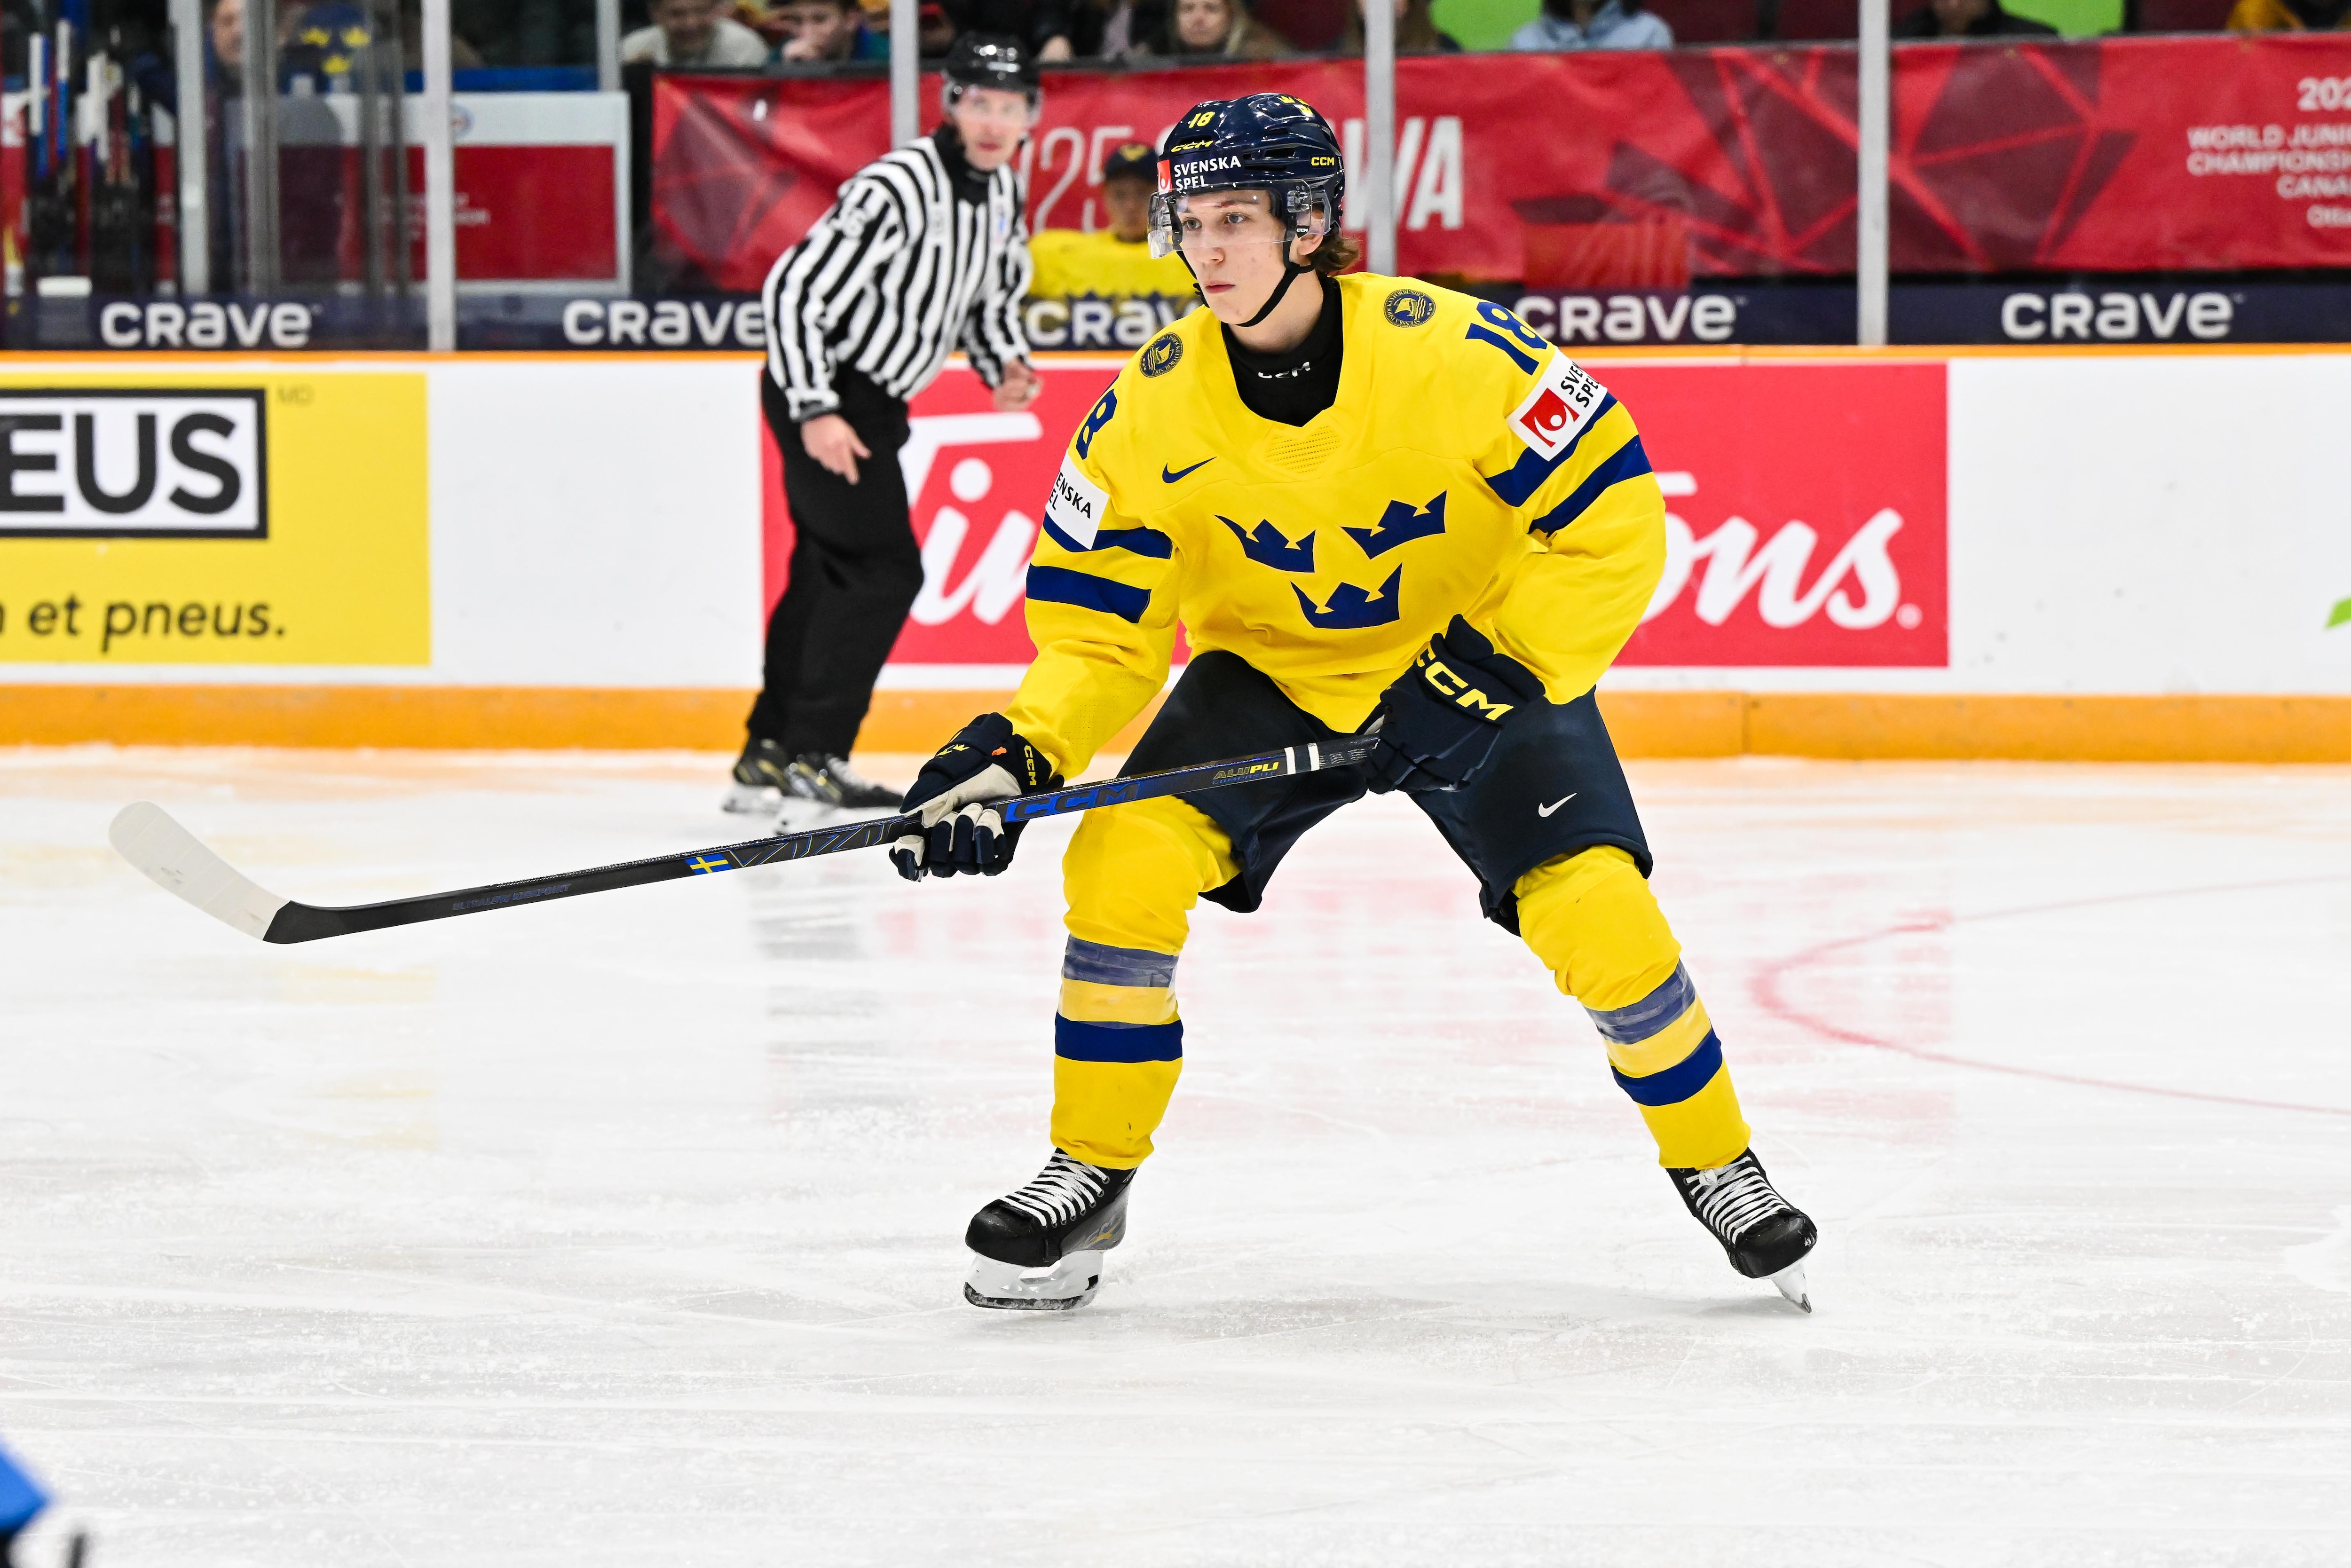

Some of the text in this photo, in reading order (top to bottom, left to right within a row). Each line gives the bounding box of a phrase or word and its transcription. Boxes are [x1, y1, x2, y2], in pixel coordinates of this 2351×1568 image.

[1188, 111, 1215, 128] 18
[1171, 141, 1214, 152] CCM
[1311, 157, 1334, 166] CCM
[1174, 155, 1242, 178] SVENSKA
[1175, 175, 1209, 191] SPEL
[1465, 301, 1548, 376] 18
[1076, 375, 1120, 460] 8
[1055, 470, 1091, 519] ENSKA
[28, 594, 85, 637] et
[101, 601, 287, 654] pneus.
[1024, 745, 1037, 786] CCM
[1213, 762, 1279, 780] ALUPLI
[1013, 783, 1139, 820] CCM
